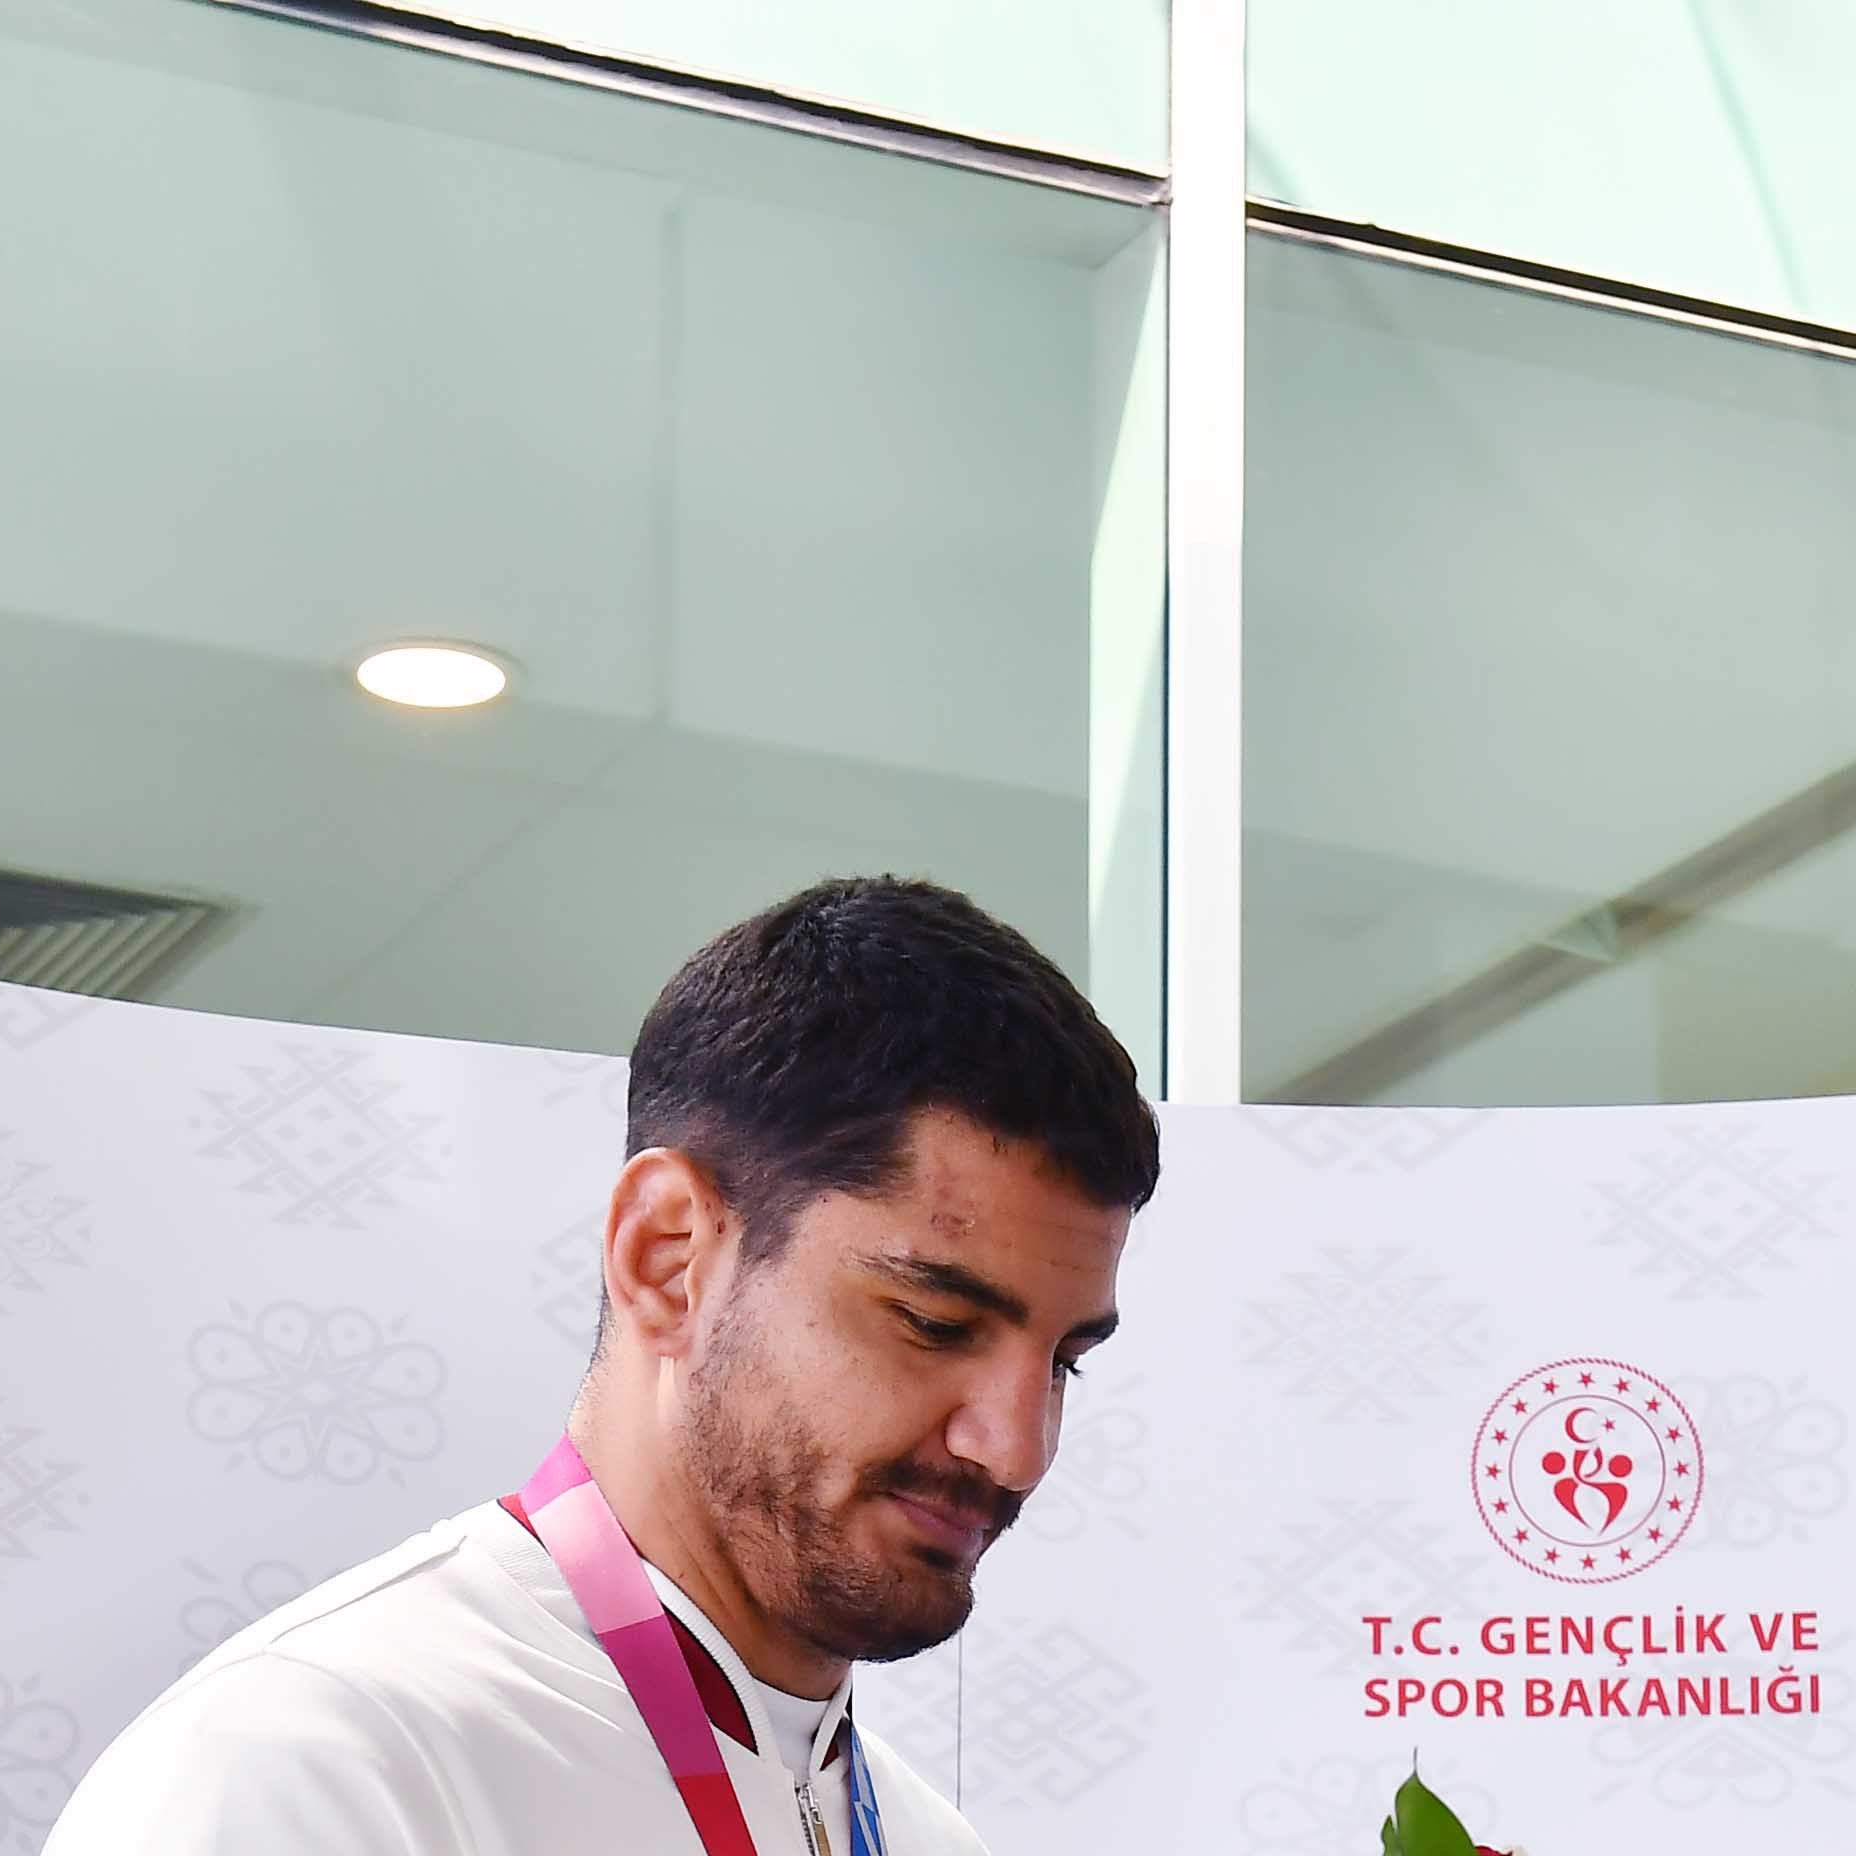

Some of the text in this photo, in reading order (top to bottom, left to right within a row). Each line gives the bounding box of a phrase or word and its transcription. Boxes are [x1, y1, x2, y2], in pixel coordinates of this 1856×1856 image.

[1362, 1605, 1819, 1666] T.C. GENÇLİK VE
[1363, 1665, 1821, 1718] SPOR BAKANLIĞI
